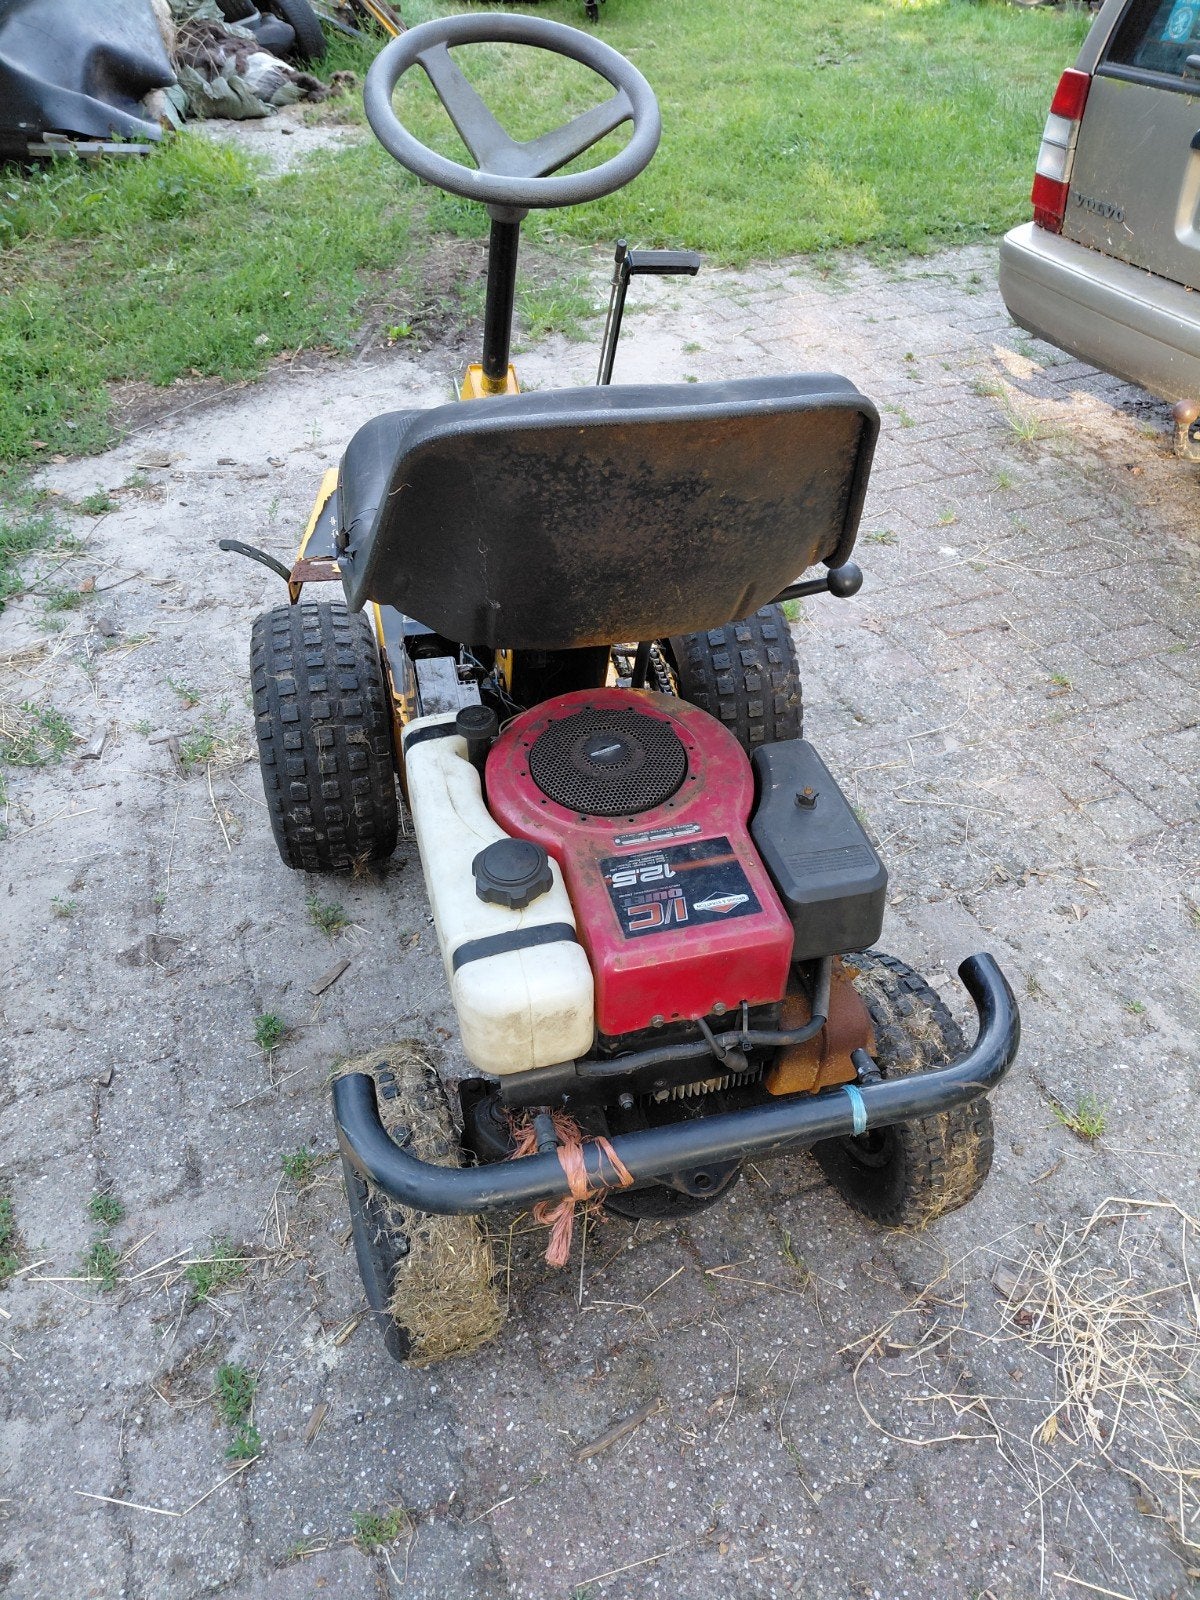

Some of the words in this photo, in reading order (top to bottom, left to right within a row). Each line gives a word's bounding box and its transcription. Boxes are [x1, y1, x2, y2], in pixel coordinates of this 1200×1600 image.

[1075, 191, 1126, 223] VOLVO
[613, 863, 676, 888] 12.5
[624, 888, 683, 907] QUIET
[628, 896, 689, 931] I/C
